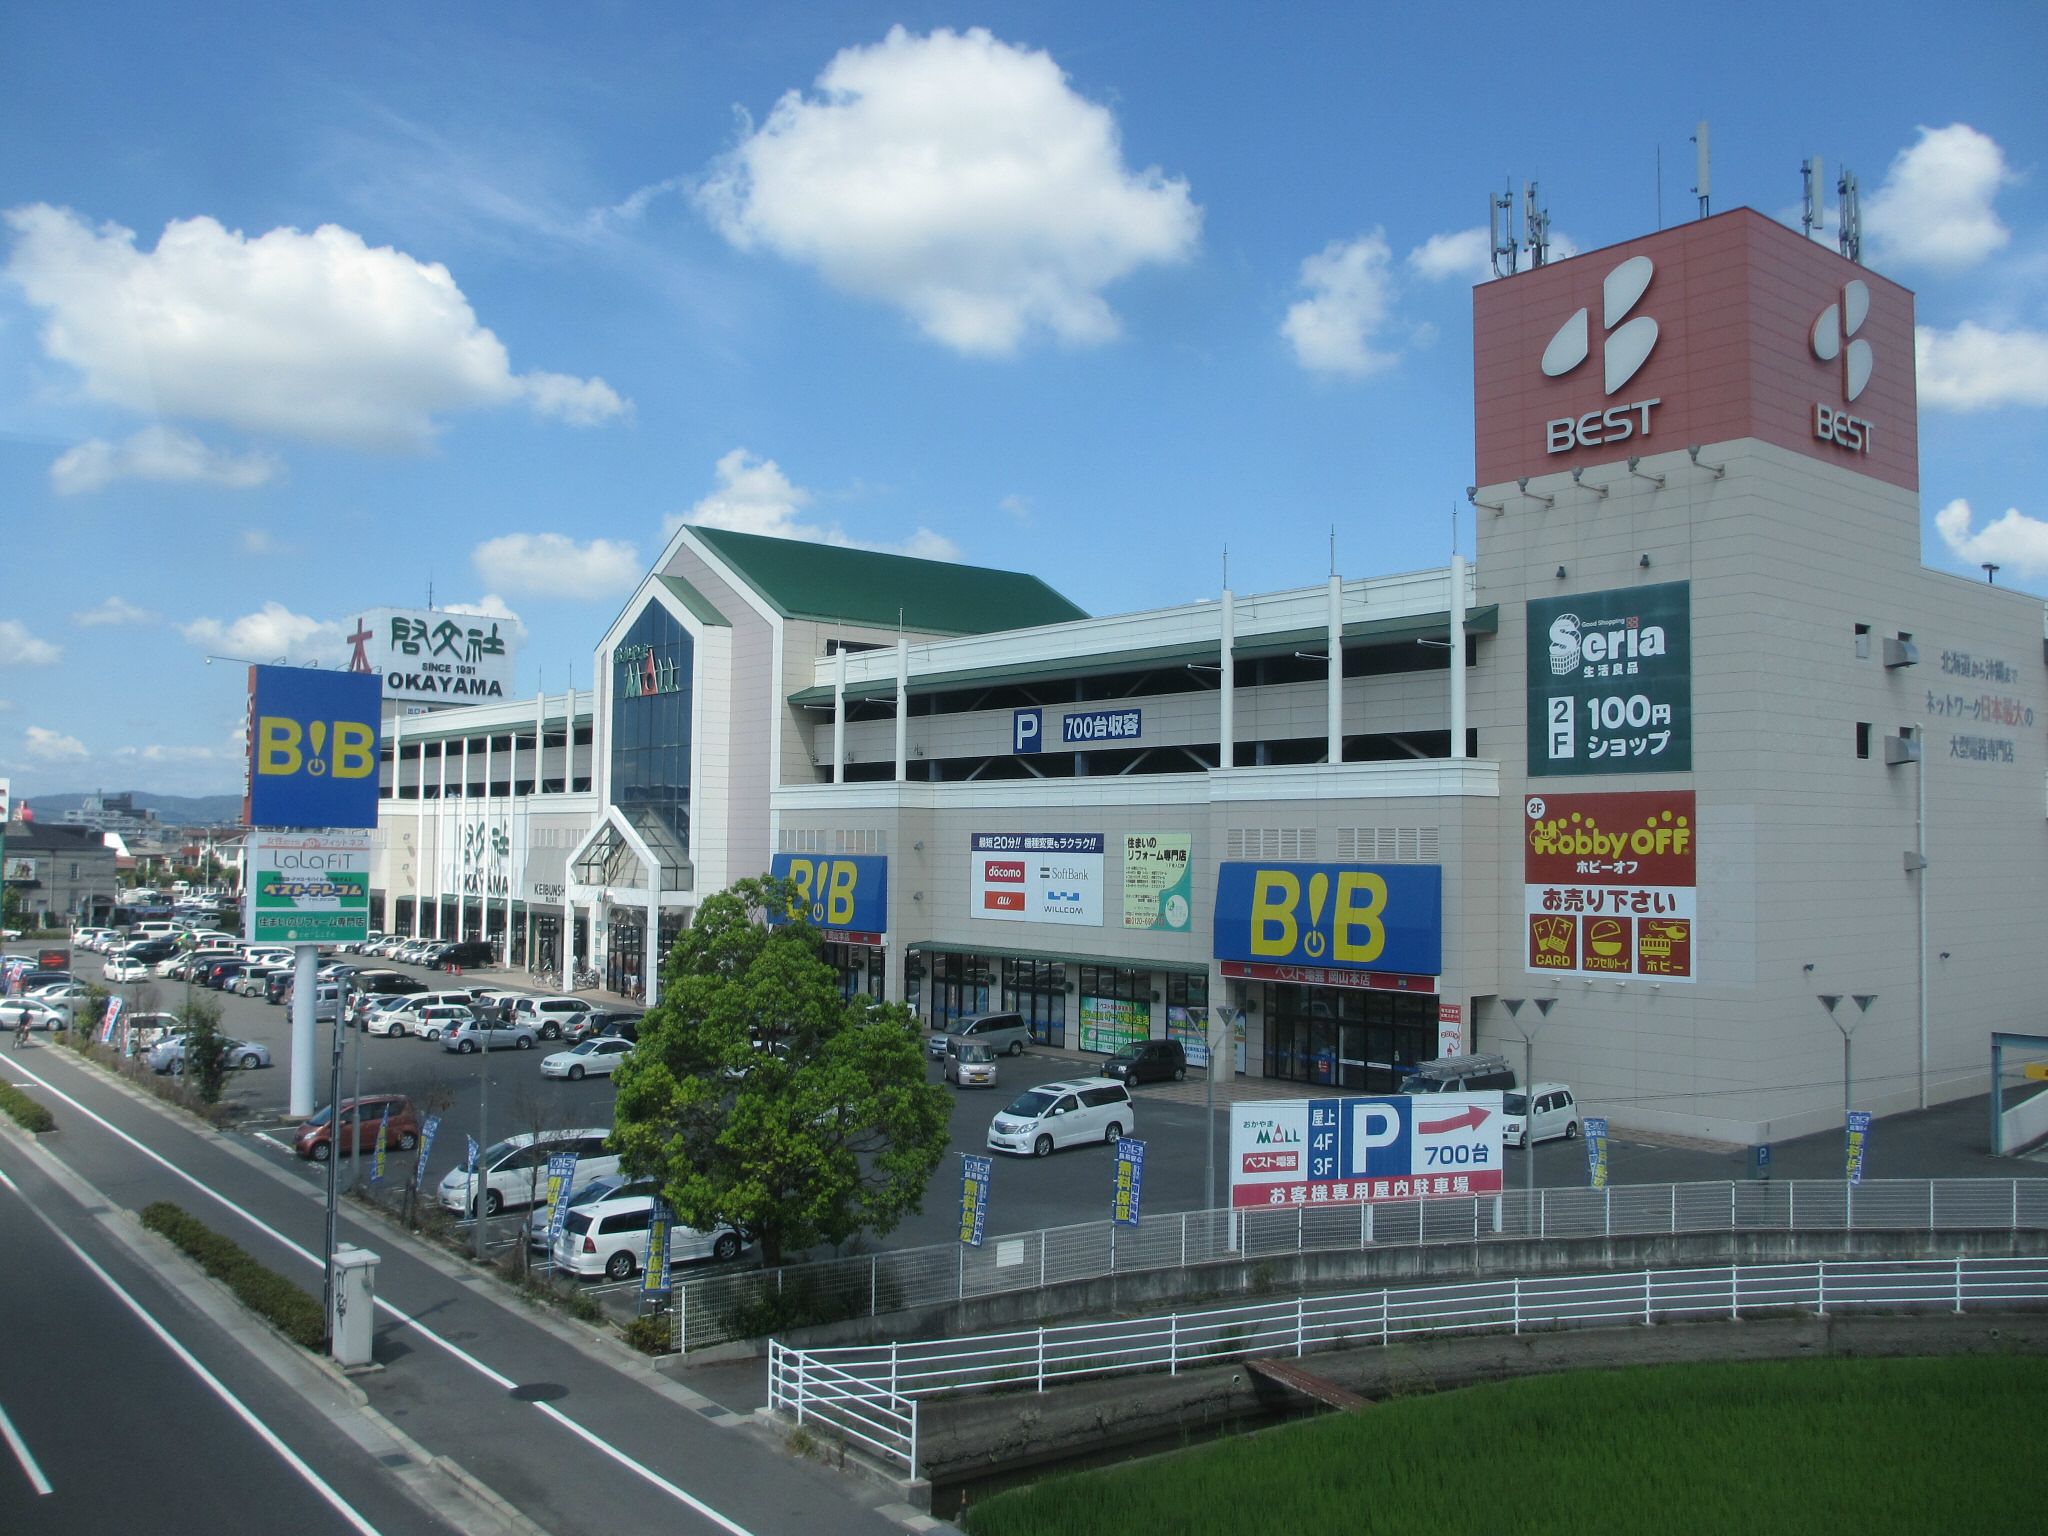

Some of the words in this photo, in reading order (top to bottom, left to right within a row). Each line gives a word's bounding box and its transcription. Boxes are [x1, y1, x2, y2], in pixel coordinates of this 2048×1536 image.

[1547, 398, 1661, 454] BEST
[1816, 402, 1875, 454] BEST
[1581, 620, 1597, 628] Good
[1598, 617, 1625, 627] Shopping
[391, 616, 505, 663] 啓文社
[1549, 614, 1666, 665] Seria
[422, 662, 452, 673] SINCE
[624, 649, 680, 698] MALL
[1583, 661, 1639, 678] 生活良品
[387, 671, 503, 697] OKAYAMA
[1587, 694, 1671, 730] 100円
[1017, 713, 1038, 750] P
[1066, 712, 1139, 740] 700台収容
[1587, 729, 1671, 759] ショップ
[1530, 802, 1543, 814] 2F
[978, 836, 1022, 849] 最短20分!!
[1024, 836, 1096, 850] 機種変更もラクラク!!
[1127, 837, 1157, 849] 住まいの
[1530, 817, 1629, 859] Hobby
[1631, 826, 1690, 855] OFF
[1128, 849, 1187, 861] リフォーム専門店
[988, 866, 1022, 878] docomo
[1052, 868, 1089, 881] SoftBank
[1576, 860, 1639, 874] ホビーオフ
[262, 882, 365, 897] ベストテレコム
[457, 873, 509, 894] KAYAMA
[997, 895, 1012, 906] au
[1542, 888, 1676, 914] お売り下さい
[1044, 906, 1084, 914] WILLCOM
[259, 917, 365, 928] 住まいのリフォーム専門店
[1536, 953, 1571, 967] CARD
[1585, 956, 1630, 970] カプセルトイ
[1646, 960, 1684, 973] ホビー
[1275, 965, 1325, 983] ベスト電器
[1328, 969, 1371, 987] 岡山本店
[1243, 1120, 1274, 1128] おかやま
[1311, 1109, 1336, 1128] 屋上
[1256, 1124, 1300, 1143] MALL
[1313, 1133, 1333, 1151] 4F
[1352, 1102, 1401, 1174] P
[1245, 1155, 1297, 1168] ベスト電器
[1424, 1143, 1489, 1165] 700台
[1313, 1157, 1333, 1176] 3F
[1269, 1176, 1470, 1204] お客様専用屋内駐車場
